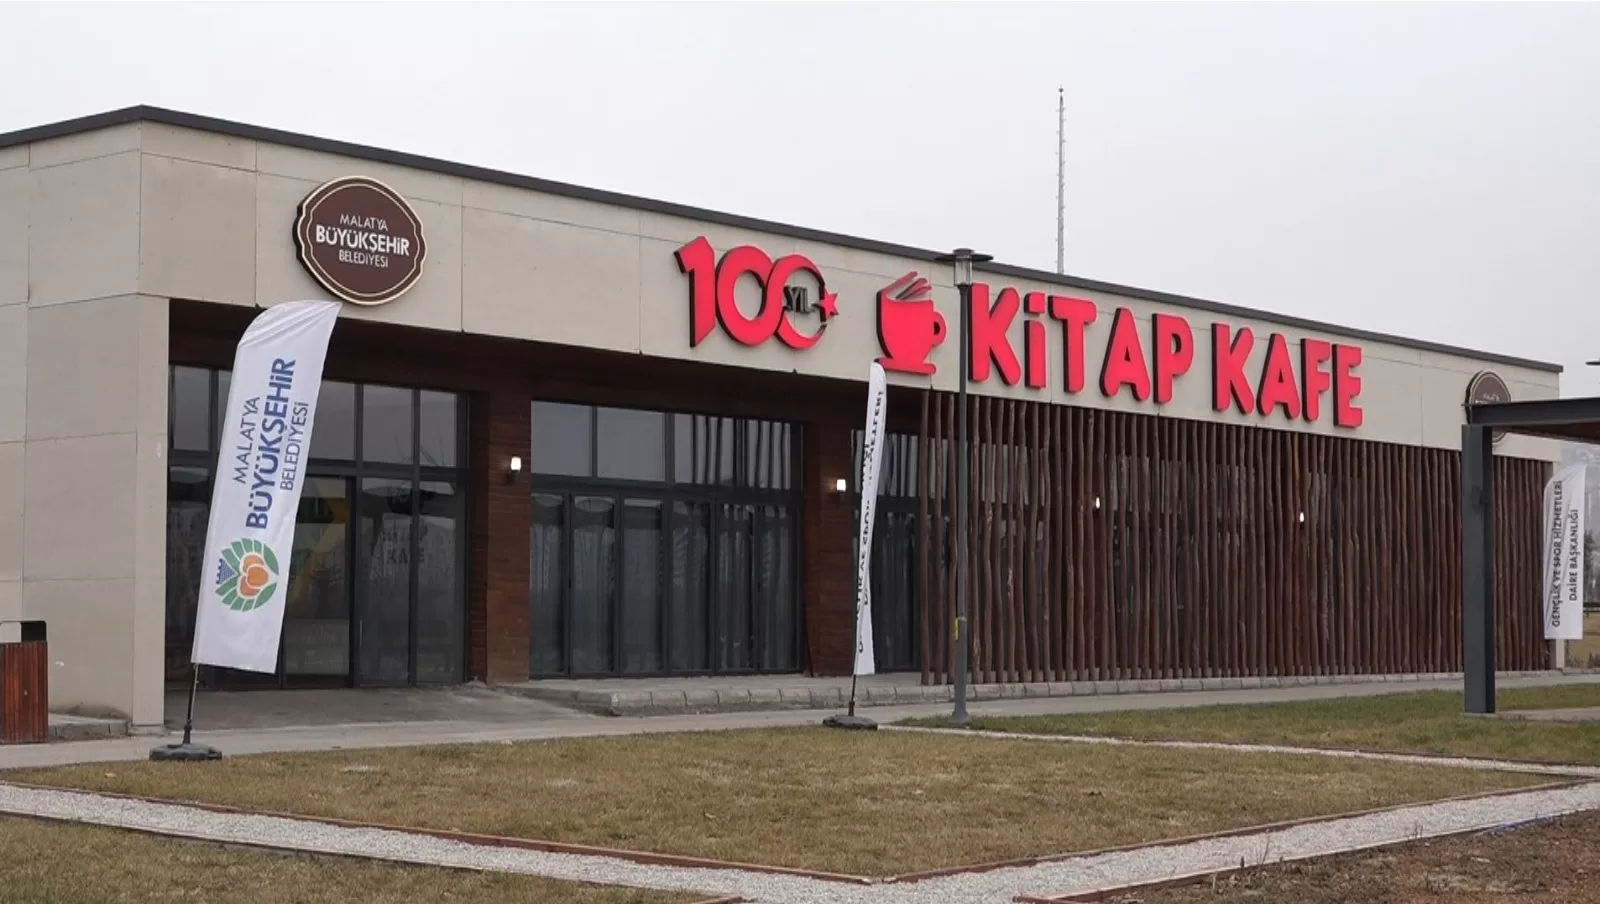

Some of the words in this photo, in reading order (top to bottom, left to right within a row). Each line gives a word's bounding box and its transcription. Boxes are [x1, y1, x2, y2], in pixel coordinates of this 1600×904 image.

[315, 224, 410, 257] BÜYÜKŞEHİR
[340, 213, 389, 232] MALATYA
[338, 249, 389, 269] BELEDİYESİ
[674, 235, 828, 353] 100
[968, 282, 1194, 404] KİTAP
[1211, 322, 1363, 428] KAFE
[232, 395, 261, 484] MALATYA
[245, 357, 297, 531] BÜYÜKŞEHİR
[280, 401, 310, 492] BELEDİYESİ
[1553, 541, 1563, 568] SPOR
[1568, 508, 1581, 569] BAŞKANLIĞI
[1553, 570, 1562, 582] VE
[1568, 571, 1579, 602] DAİRE
